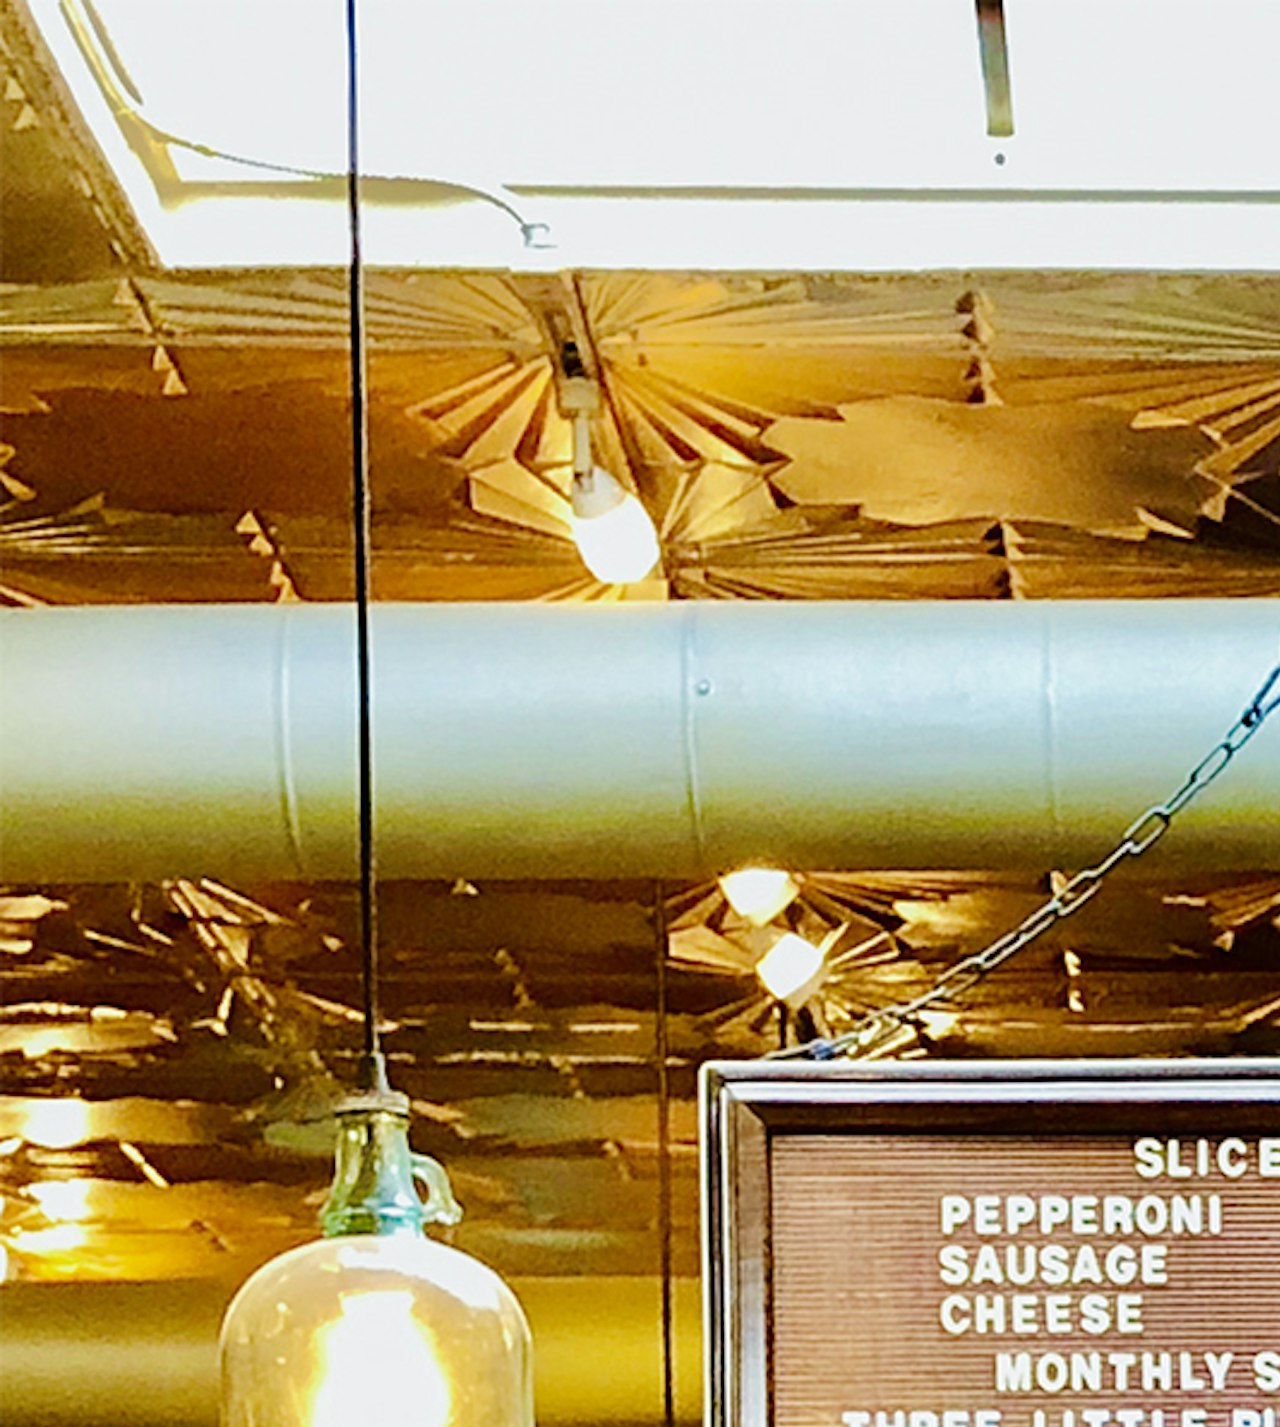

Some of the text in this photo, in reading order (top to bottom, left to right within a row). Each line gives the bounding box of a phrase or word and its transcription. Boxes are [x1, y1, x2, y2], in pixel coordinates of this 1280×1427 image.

[941, 1195, 1221, 1235] PEPPERONI
[940, 1244, 1168, 1284] SAUSAGE
[941, 1294, 1144, 1334] CHEESE
[996, 1351, 1235, 1392] MONTHLY
